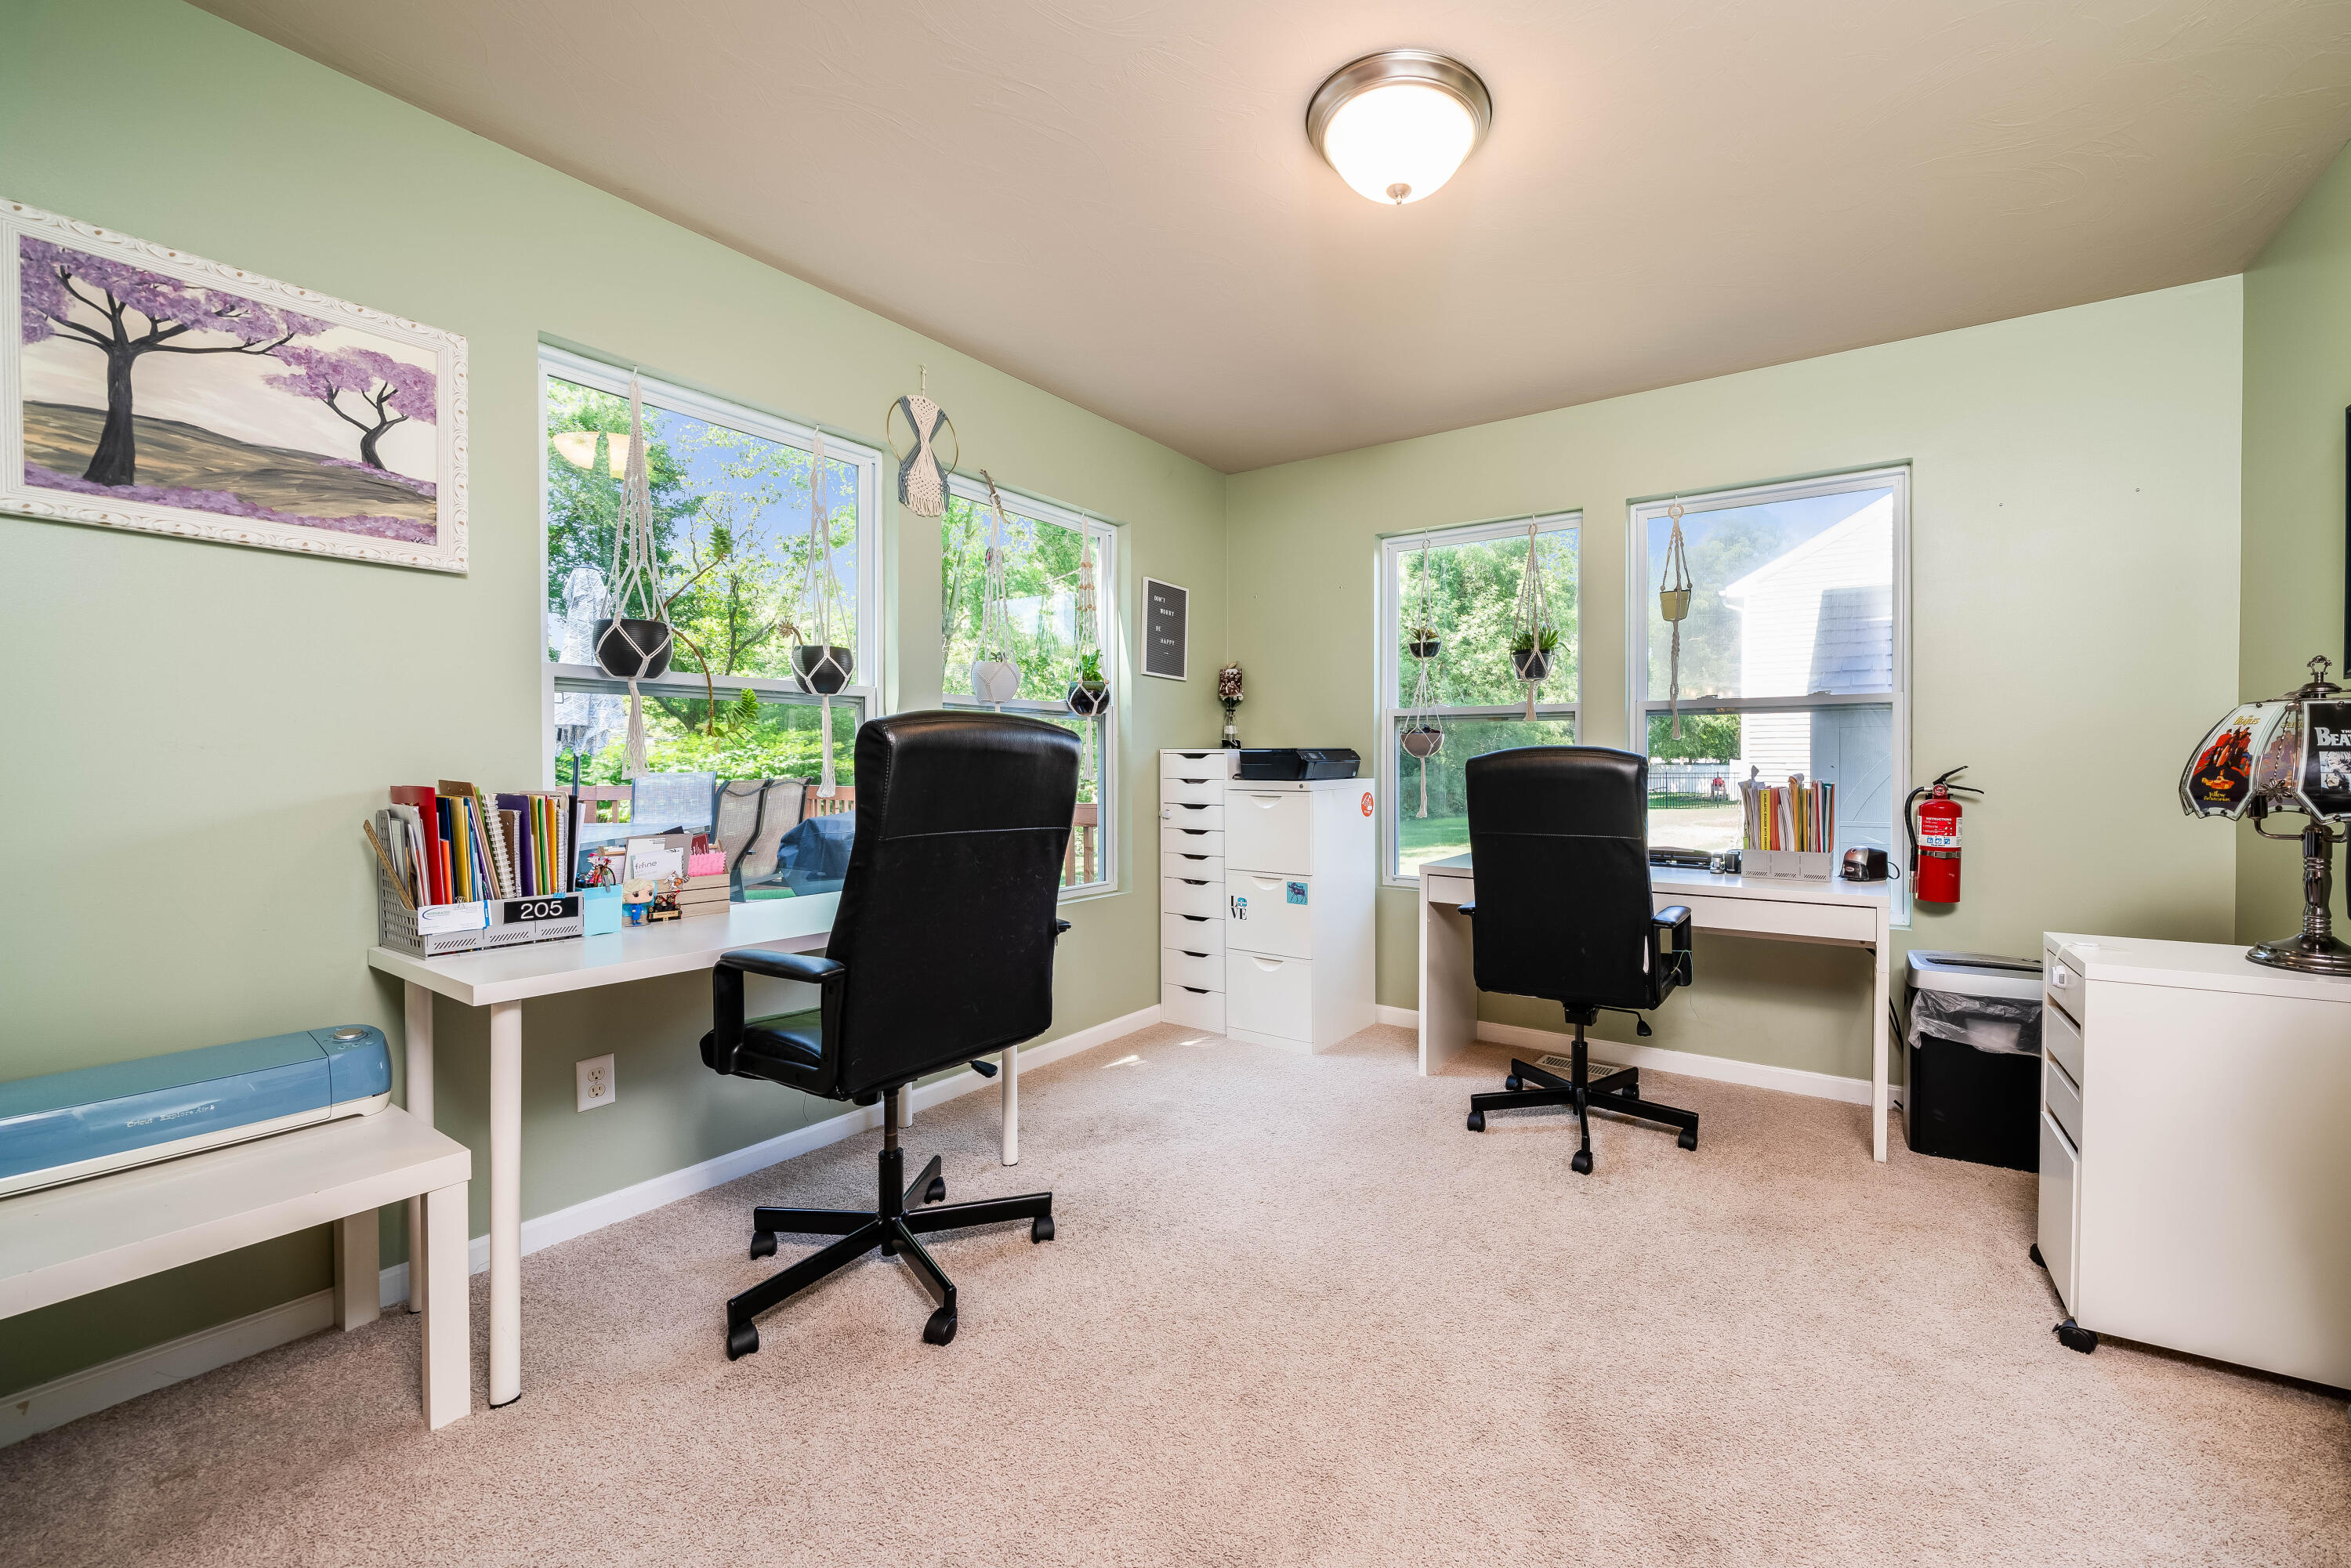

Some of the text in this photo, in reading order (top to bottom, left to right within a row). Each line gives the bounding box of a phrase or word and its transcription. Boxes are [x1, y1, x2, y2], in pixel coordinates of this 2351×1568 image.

[1161, 608, 1174, 617] WORRY
[520, 900, 563, 920] 205
[126, 1118, 153, 1128] Cricut
